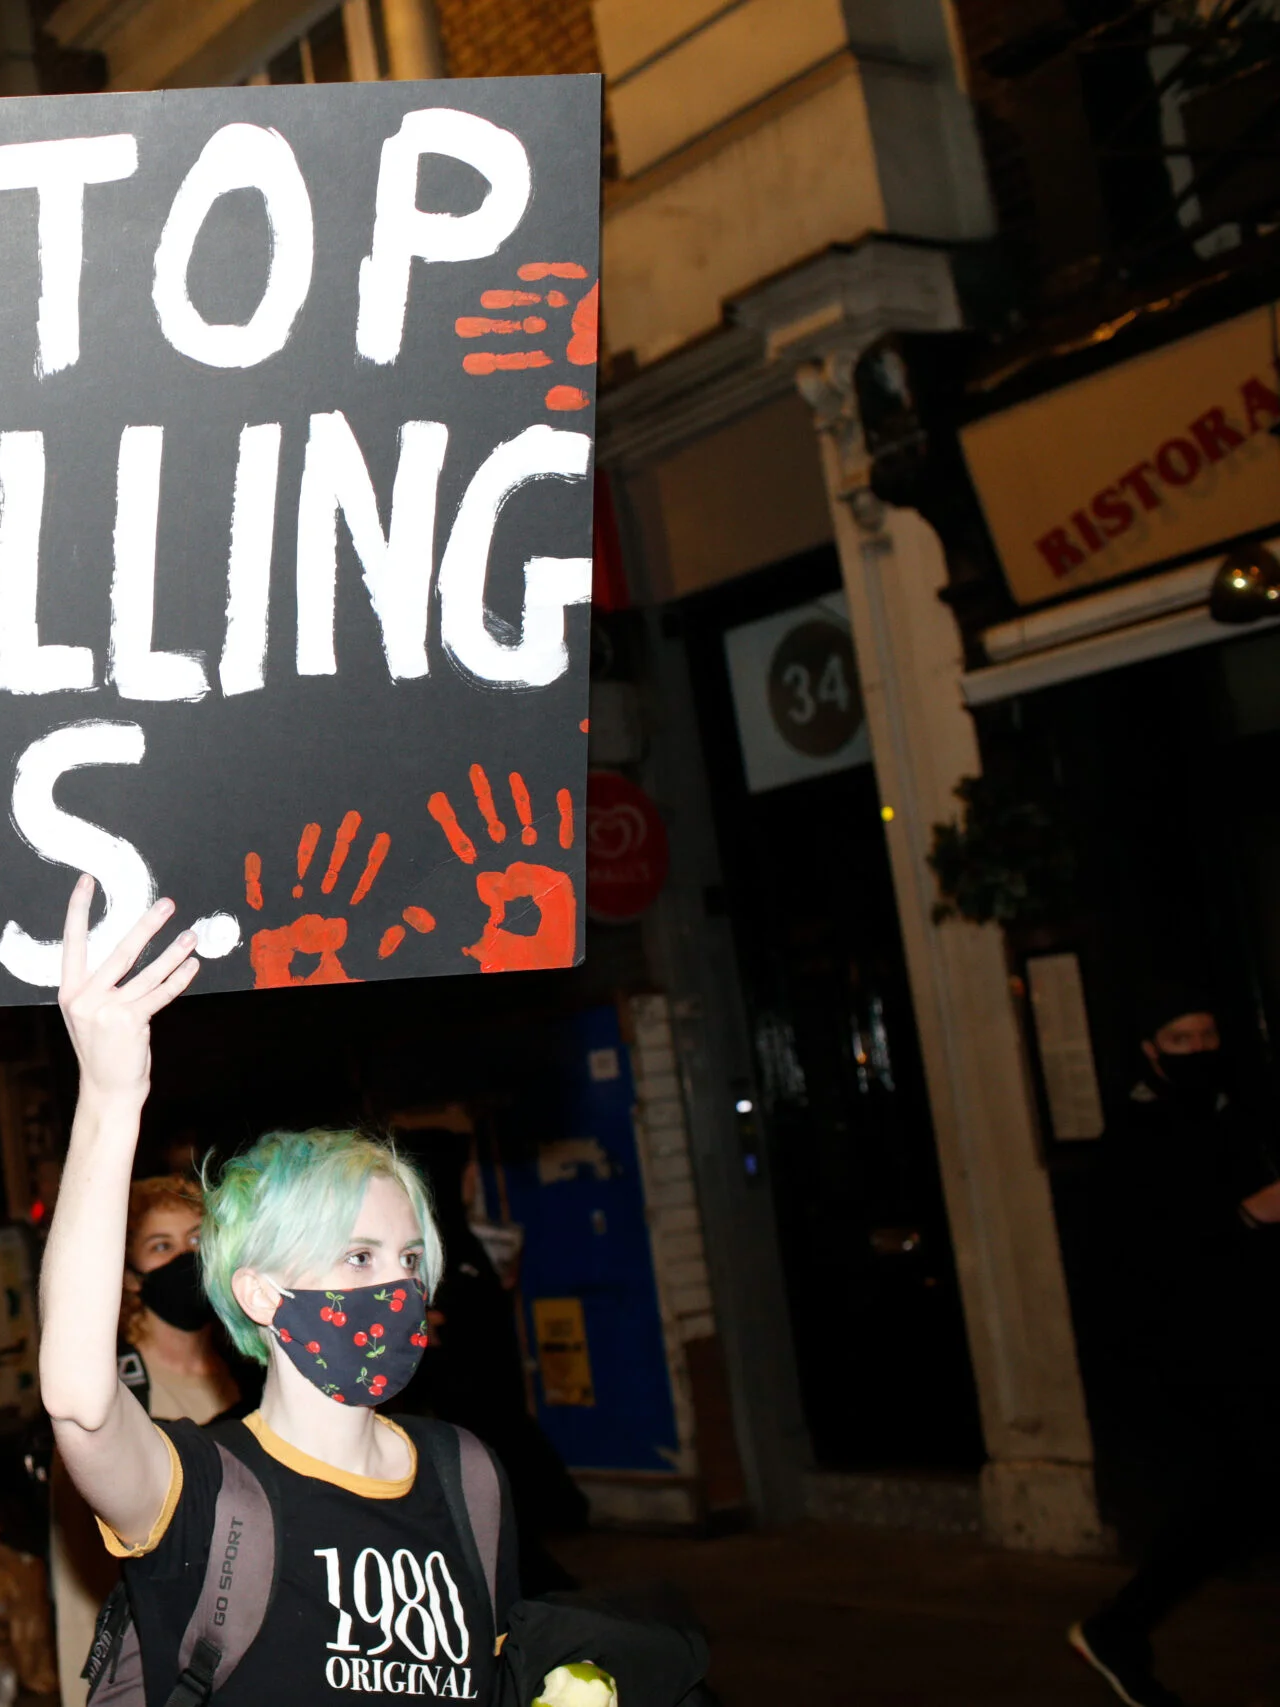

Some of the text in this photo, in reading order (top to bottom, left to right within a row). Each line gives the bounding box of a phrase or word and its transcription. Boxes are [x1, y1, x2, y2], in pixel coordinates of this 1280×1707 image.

[1035, 355, 1280, 578] RISTORA
[781, 652, 850, 726] 34
[214, 1516, 243, 1626] GO SPORT
[313, 1547, 469, 1665] 1980
[325, 1655, 479, 1700] ORIGINAL
